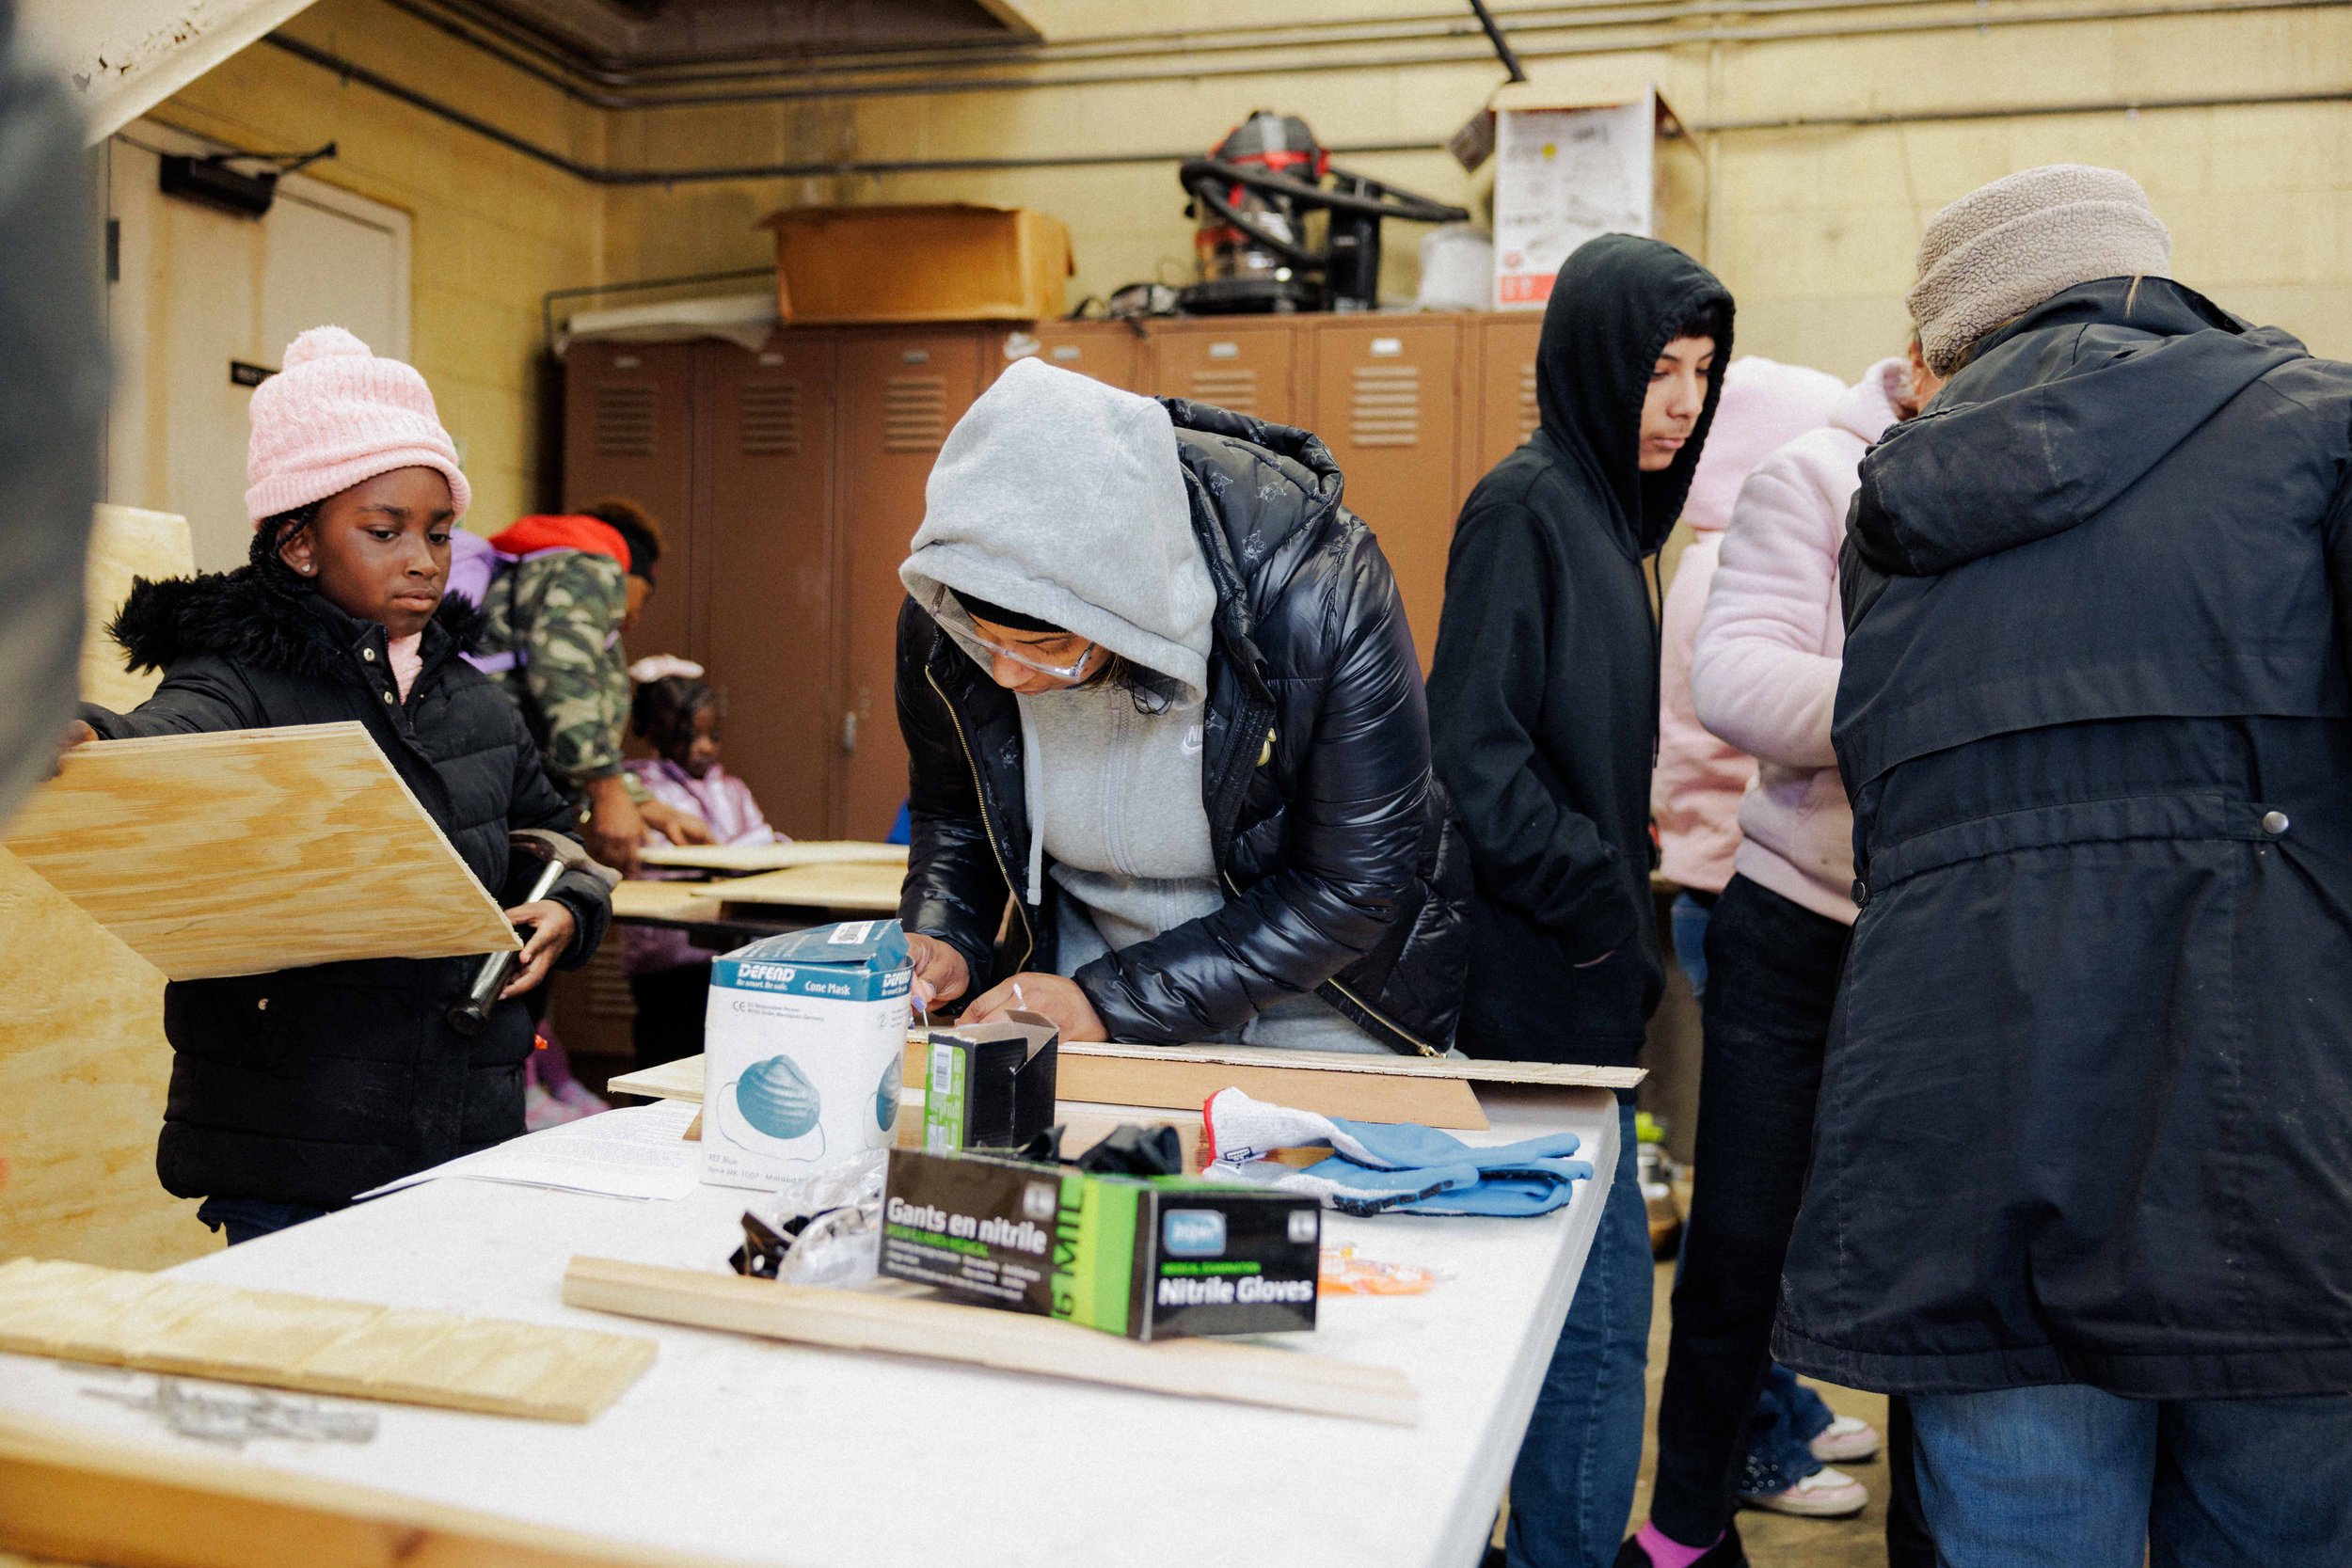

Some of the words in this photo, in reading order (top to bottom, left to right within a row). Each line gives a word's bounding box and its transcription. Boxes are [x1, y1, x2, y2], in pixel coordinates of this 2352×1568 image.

[738, 962, 796, 982] DEFEND
[805, 980, 827, 994] Cone
[828, 983, 850, 996] Mask
[765, 1174, 797, 1183] Molded
[887, 1196, 946, 1233] Gants
[948, 1213, 977, 1240] en
[977, 1216, 1048, 1256] nitrile
[1054, 1187, 1085, 1277] MIL
[1157, 1275, 1235, 1306] Nitrile
[1236, 1275, 1314, 1304] Gloves
